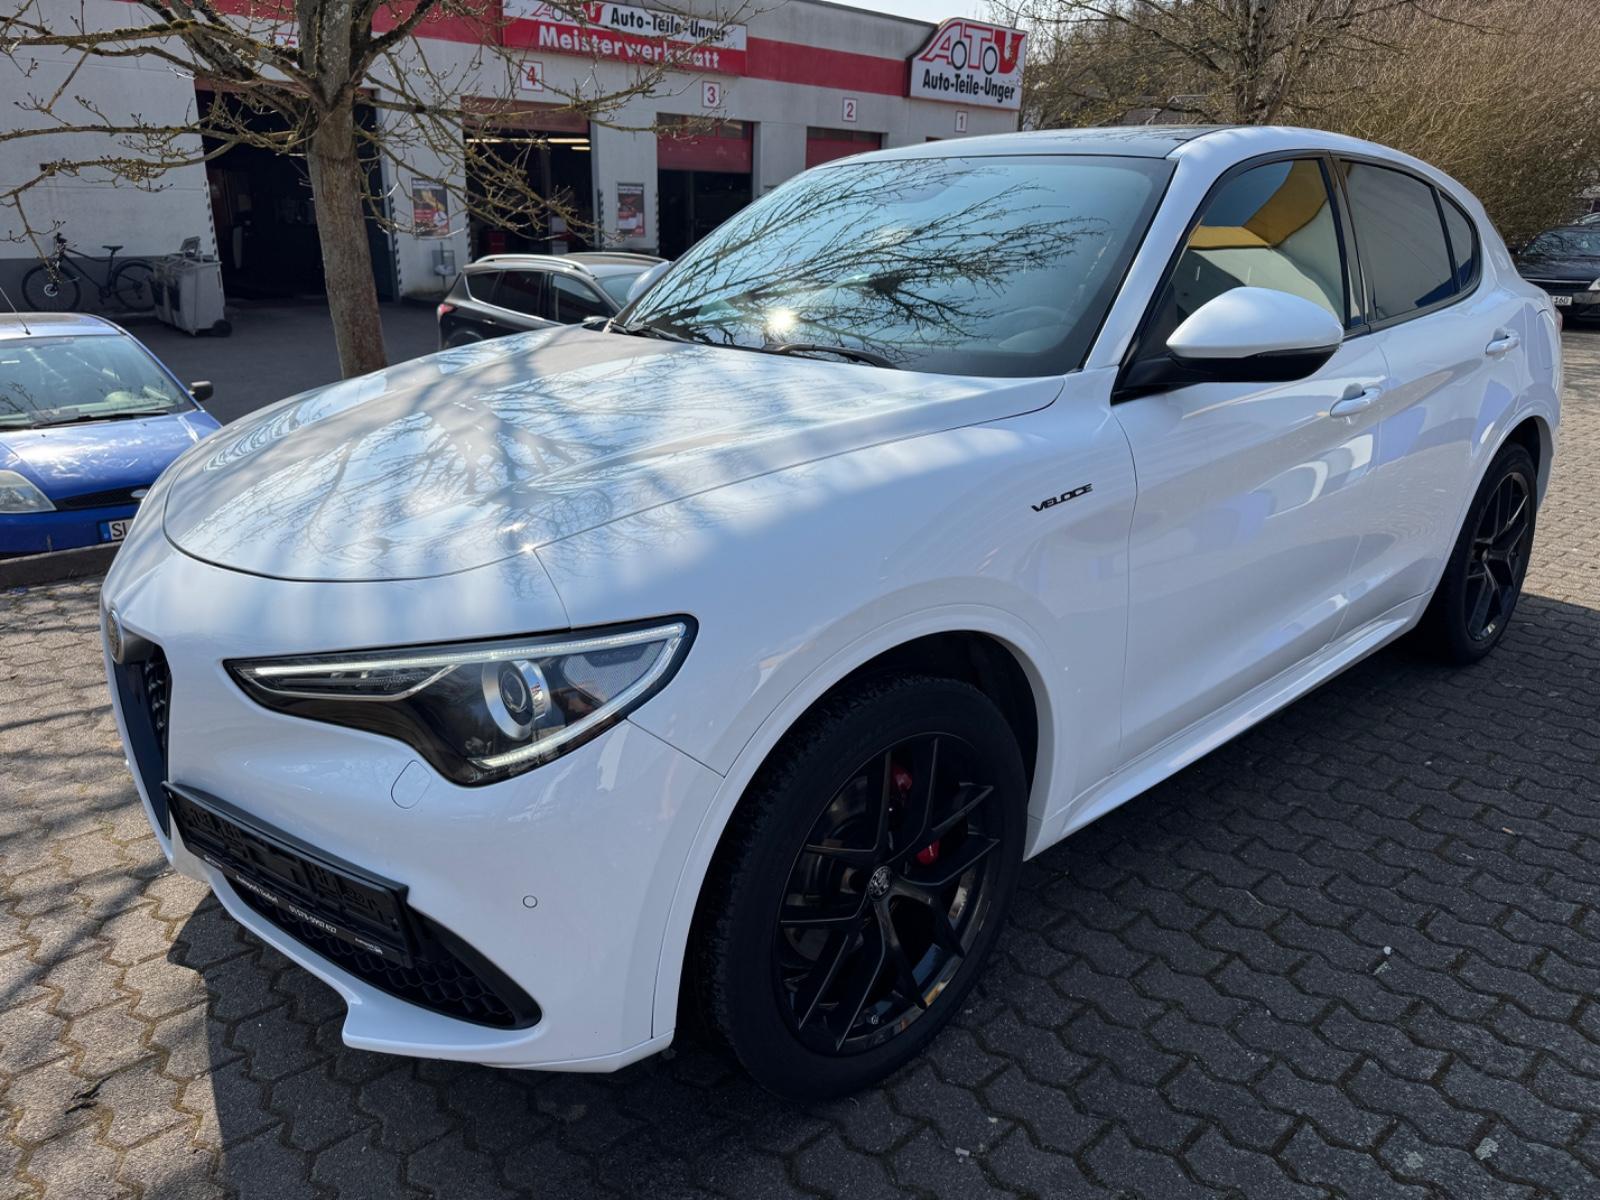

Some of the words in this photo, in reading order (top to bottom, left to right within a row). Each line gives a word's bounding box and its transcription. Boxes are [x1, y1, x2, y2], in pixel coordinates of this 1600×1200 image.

[532, 1, 605, 24] AU
[610, 7, 725, 42] Auto-Teile-Unr
[539, 25, 719, 68] Meisterwerksatt
[922, 68, 1015, 103] Auto-Teile-Unger
[1031, 483, 1093, 512] VELOCE
